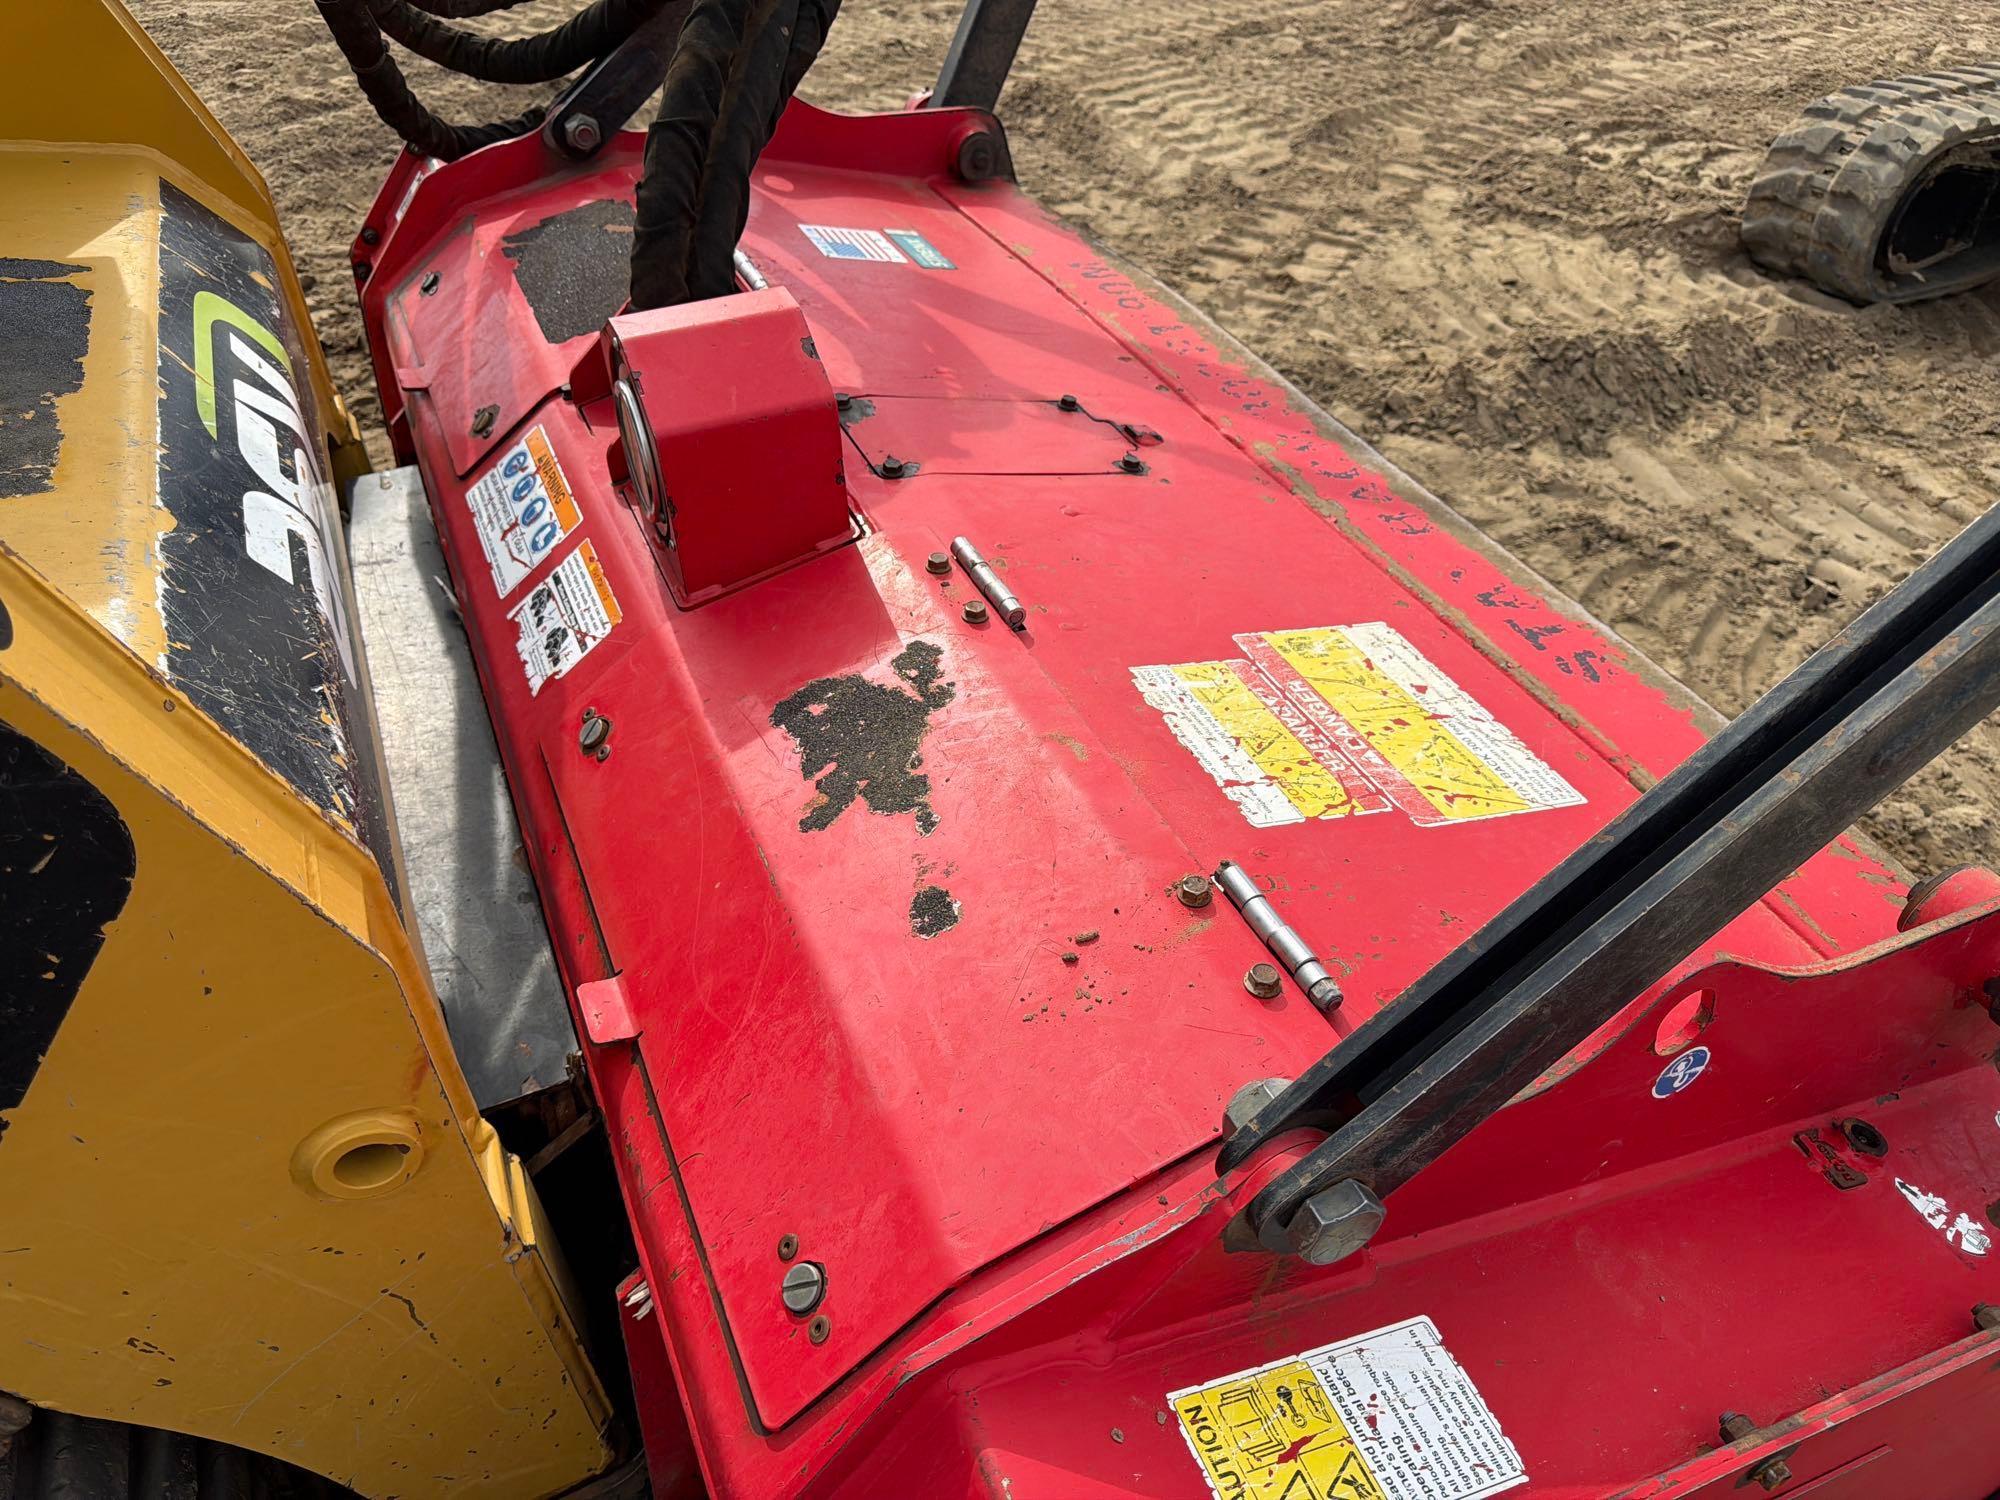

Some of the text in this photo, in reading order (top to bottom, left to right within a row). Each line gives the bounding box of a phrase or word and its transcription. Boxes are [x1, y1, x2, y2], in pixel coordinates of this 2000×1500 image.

[539, 457, 566, 506] WARNING
[1283, 679, 1370, 750] DANGER
[1478, 753, 1512, 778] BACK
[1409, 1330, 1417, 1338] in
[1415, 1340, 1435, 1366] result
[1352, 1400, 1388, 1449] maal
[1409, 1371, 1484, 1485] See owner's manual for
[1409, 1413, 1433, 1448] require
[1448, 1392, 1474, 1426] comply
[1184, 1405, 1248, 1500] AUTION
[1317, 1369, 1403, 1500] ead and understand
[1452, 1417, 1495, 1480] mintenance
[1474, 1429, 1482, 1439] to
[1480, 1420, 1517, 1472] equipment
[1392, 1432, 1435, 1500] operating.
[1421, 1456, 1449, 1498] Periodic
[1432, 1451, 1451, 1477] bolts
[1438, 1437, 1472, 1489] tightening.
[1482, 1442, 1506, 1476] Failure
[1448, 1480, 1461, 1492] All
